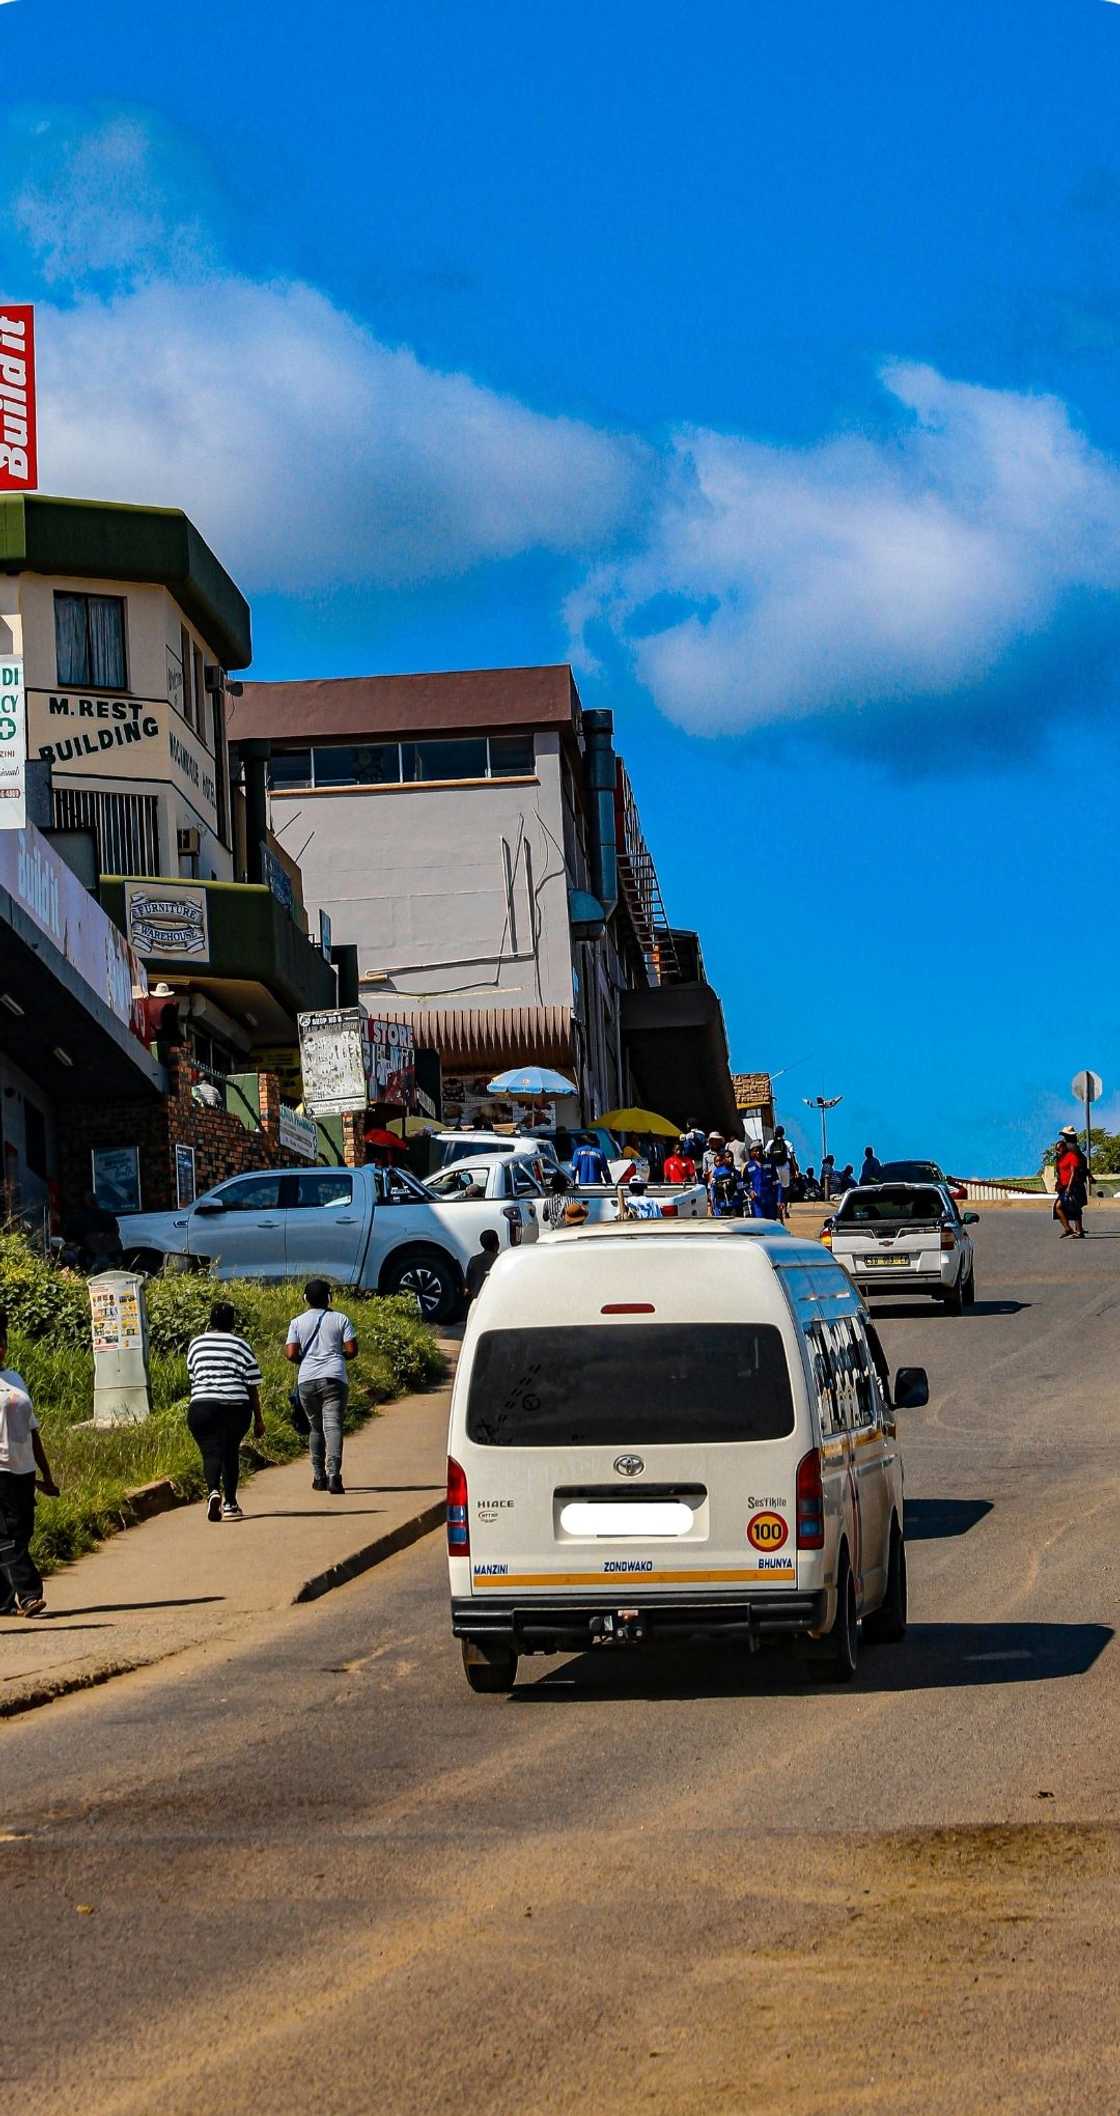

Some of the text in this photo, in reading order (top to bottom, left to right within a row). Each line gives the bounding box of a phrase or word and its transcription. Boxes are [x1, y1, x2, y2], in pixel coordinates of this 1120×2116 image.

[0, 315, 29, 481] Build it
[49, 697, 144, 721] M.REST
[38, 716, 160, 765] BUILDING
[138, 903, 197, 920] FURNITURE
[141, 926, 197, 941] WAREHOUSE
[373, 1020, 415, 1049] STORE
[477, 1499, 515, 1508] HIACE
[754, 1523, 782, 1540] 100
[474, 1564, 509, 1575] MANZINI
[604, 1560, 653, 1572] ZONDWAKO
[758, 1557, 793, 1569] BHUNYA
